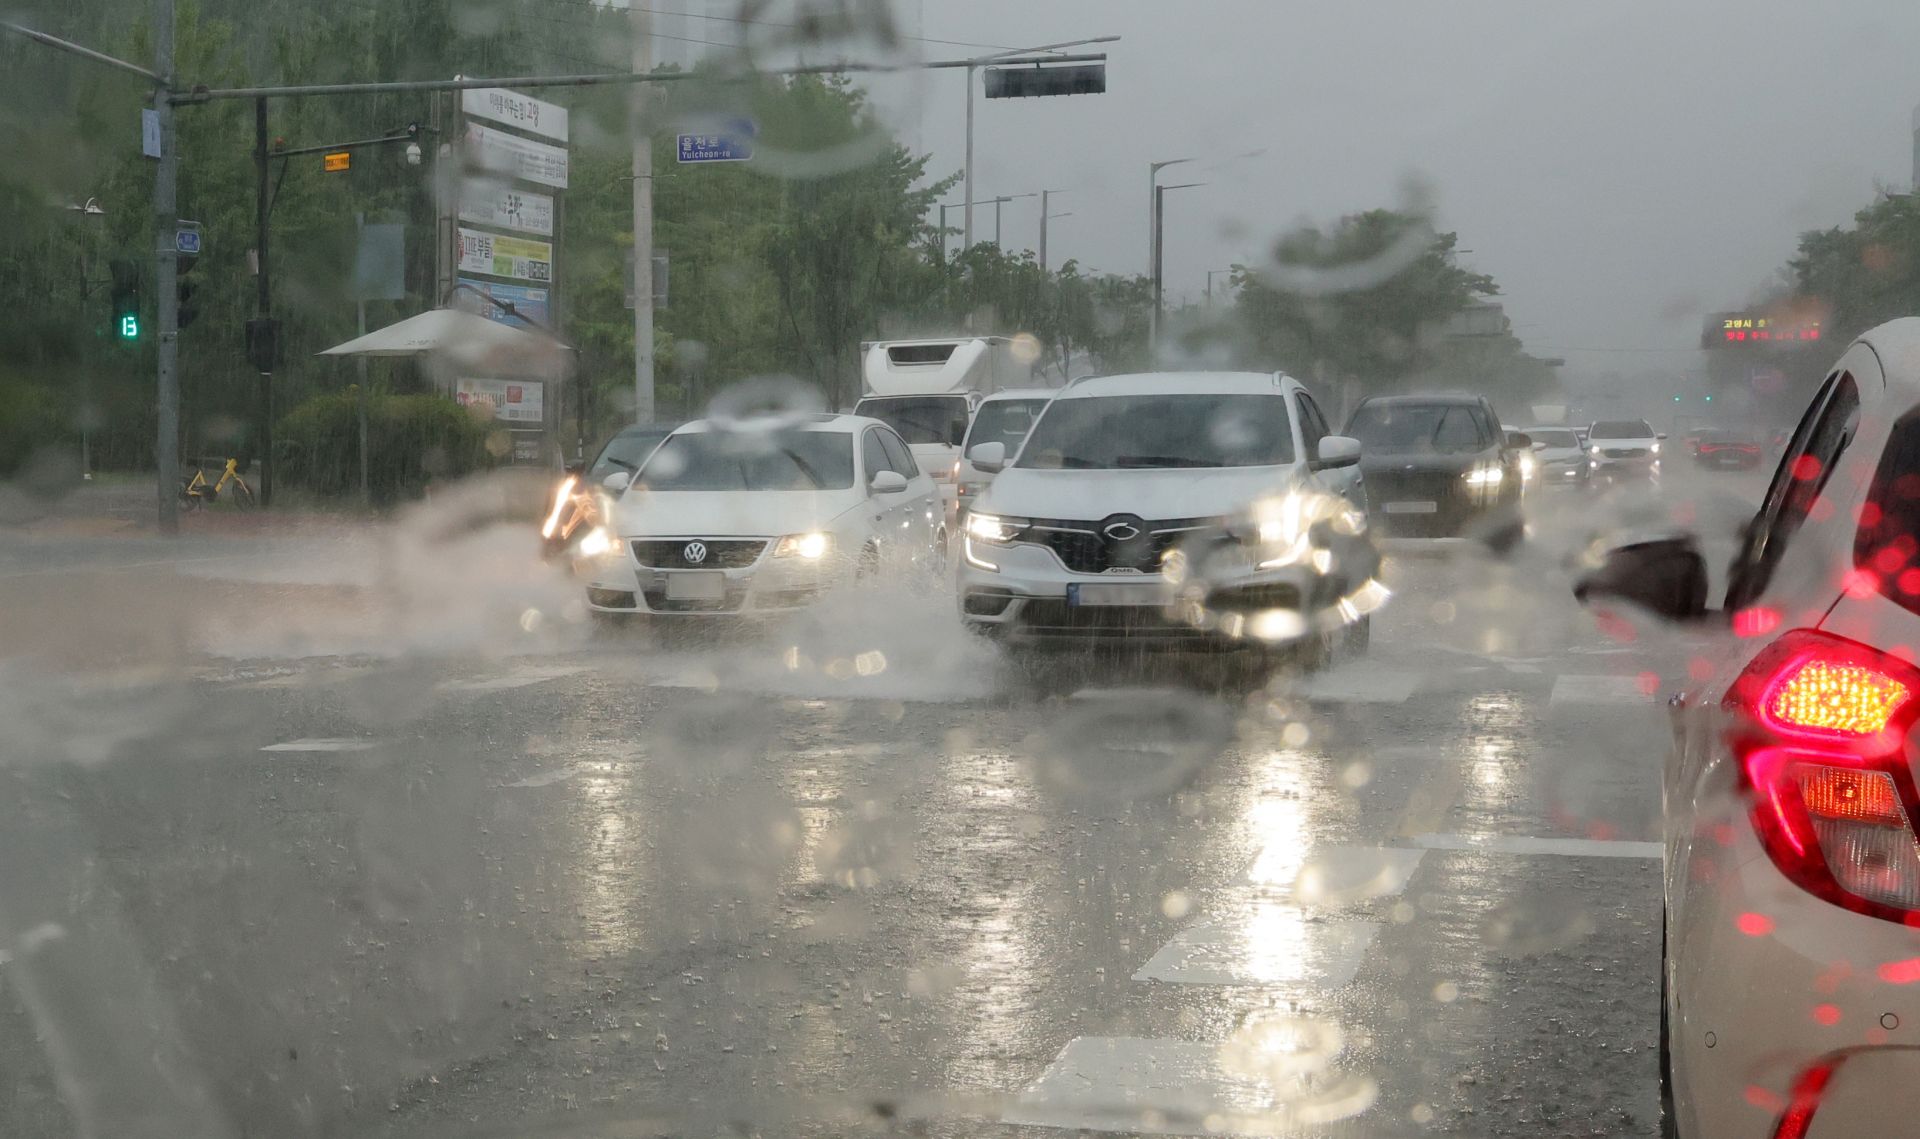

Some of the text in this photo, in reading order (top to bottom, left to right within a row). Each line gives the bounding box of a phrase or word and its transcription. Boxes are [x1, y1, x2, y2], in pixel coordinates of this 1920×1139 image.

[527, 102, 539, 127] 고양
[682, 151, 731, 159] Yulcheon-ro
[122, 317, 137, 336] 13
